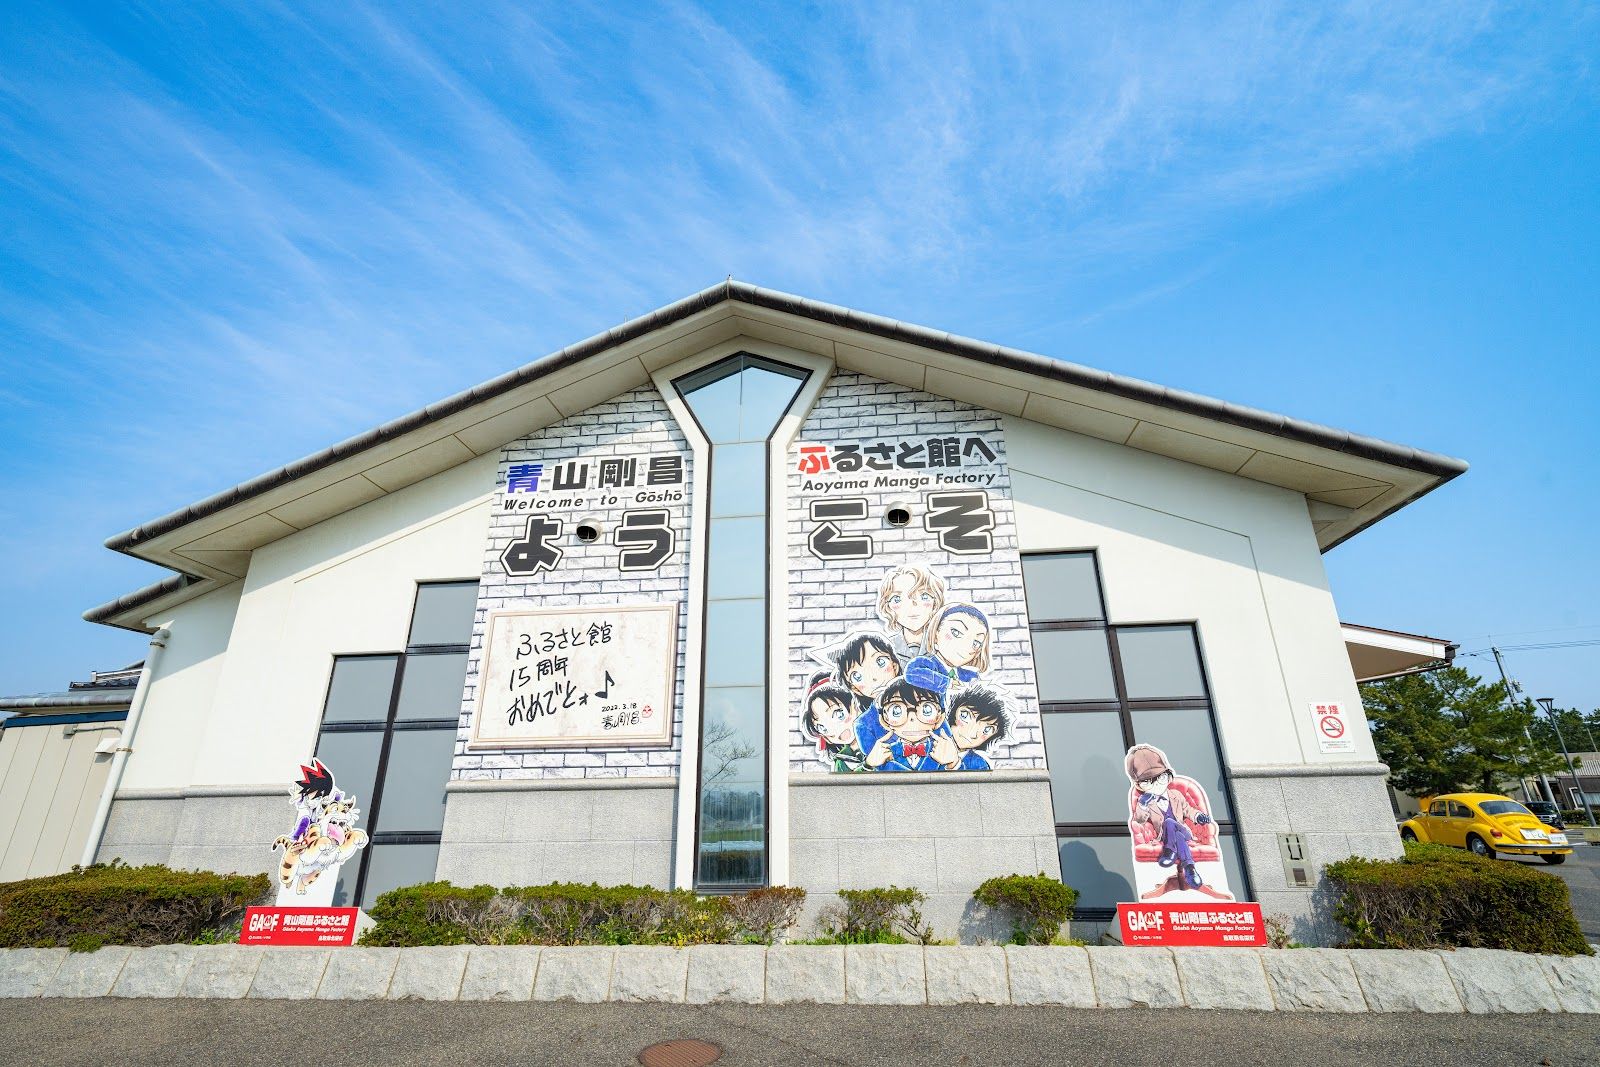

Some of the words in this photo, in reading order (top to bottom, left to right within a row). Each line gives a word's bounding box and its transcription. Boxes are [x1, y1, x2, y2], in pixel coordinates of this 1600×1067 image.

[797, 437, 997, 475] ふるさと館へ
[506, 455, 683, 494] 青山剛昌
[802, 480, 869, 494] Aoyama
[873, 475, 930, 489] Manga
[935, 472, 996, 486] Factory
[503, 498, 584, 511] Welcome
[600, 493, 618, 506] to
[635, 489, 683, 503] Gōshō
[516, 621, 613, 660] ふるさと館
[509, 656, 569, 691] 15周年
[1316, 705, 1340, 715] 禁煙
